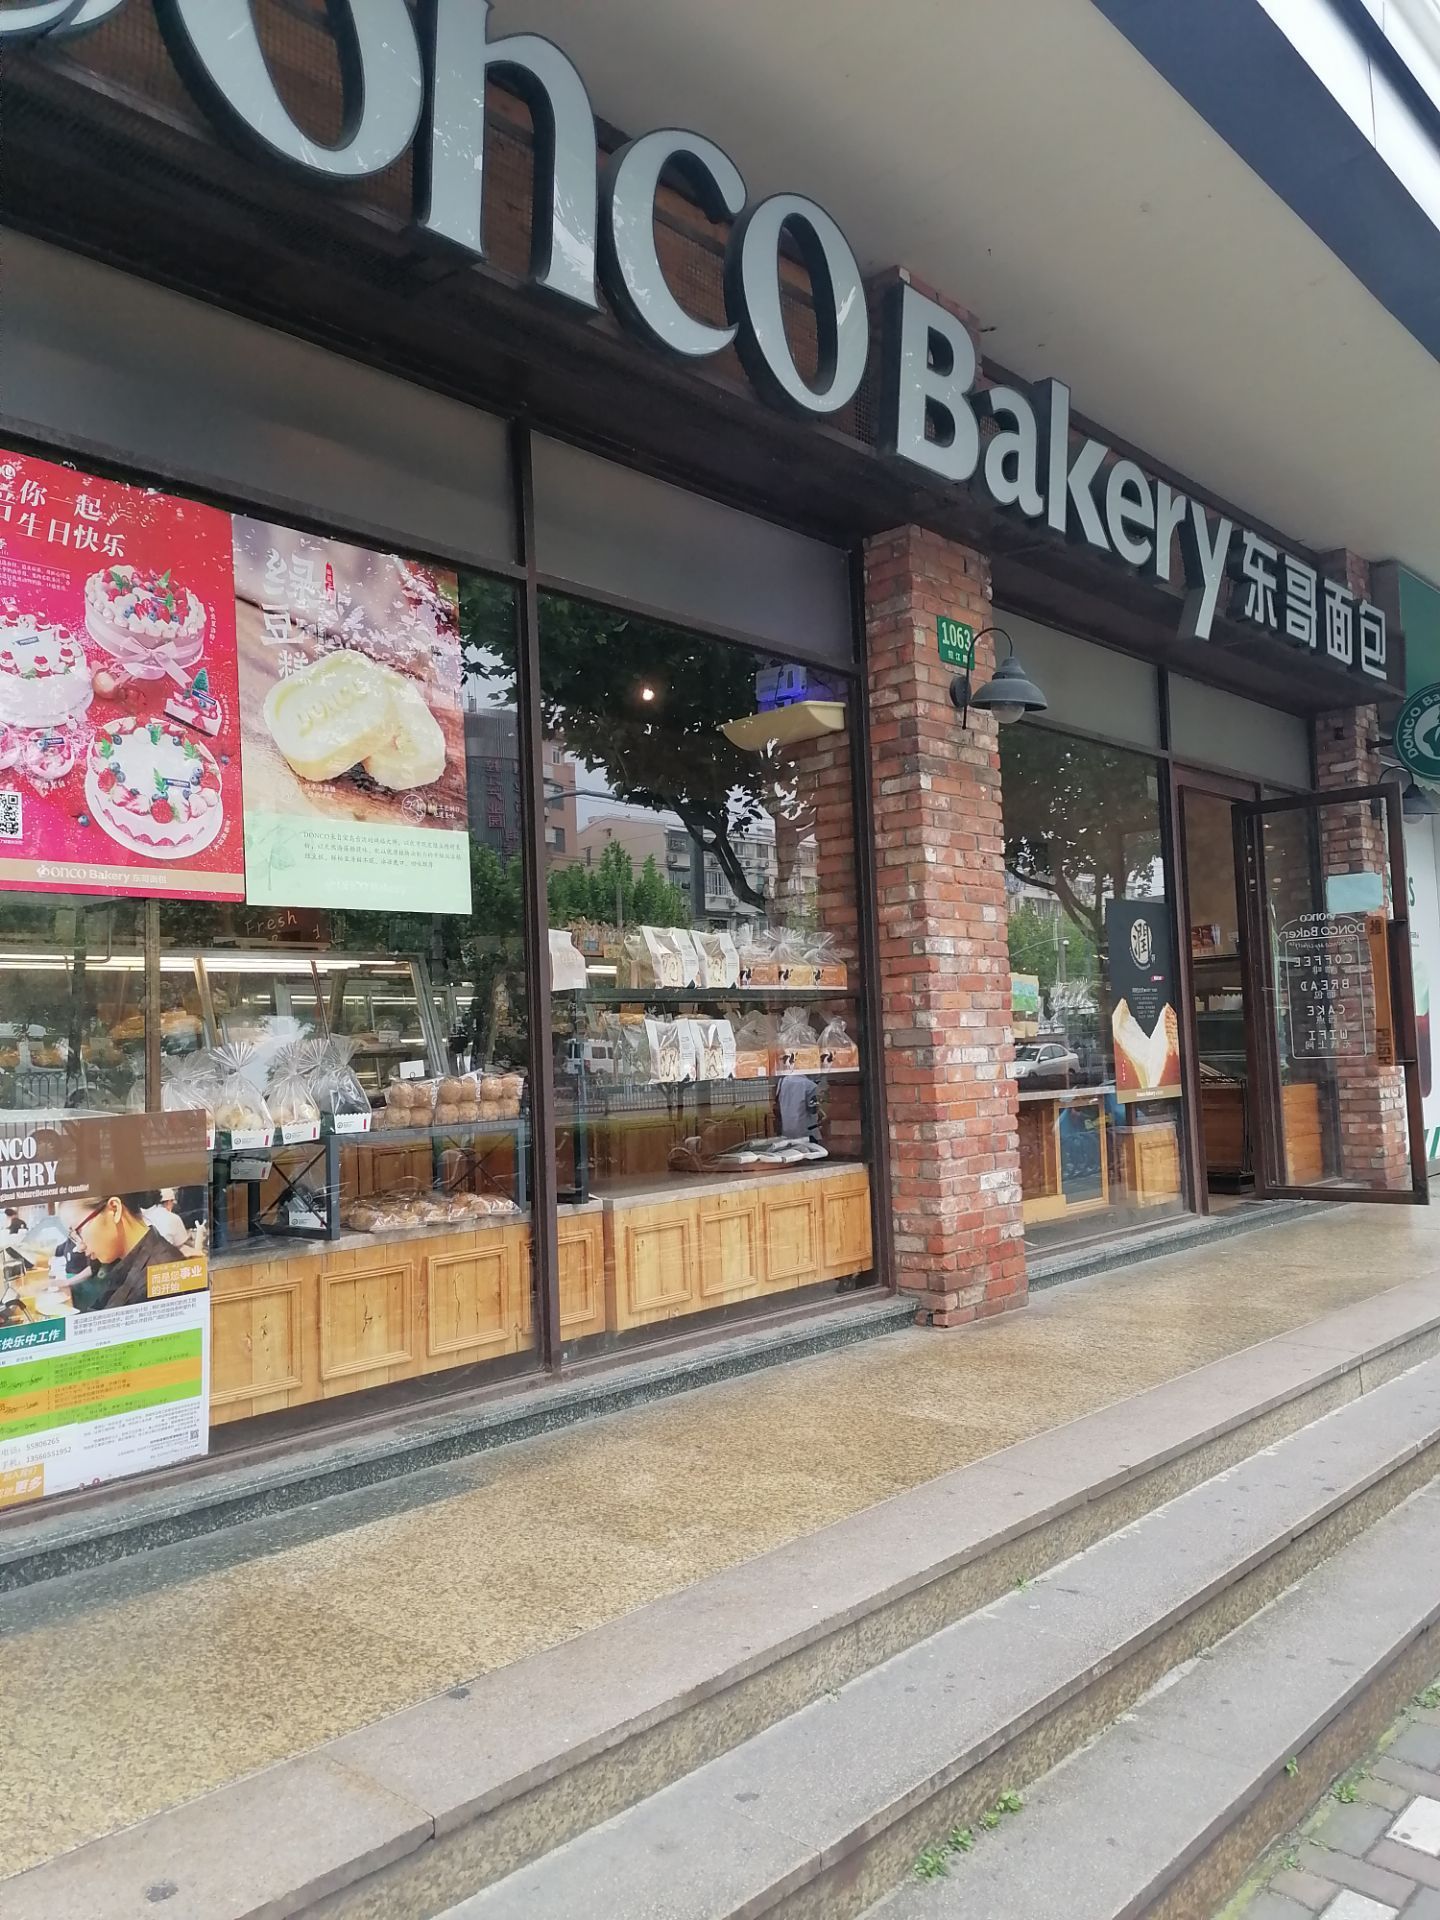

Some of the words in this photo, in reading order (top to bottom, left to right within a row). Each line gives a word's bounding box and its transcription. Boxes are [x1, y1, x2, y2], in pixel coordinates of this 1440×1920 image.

[897, 283, 1233, 641] Bakery
[1242, 530, 1388, 681] 东哥面包
[942, 621, 971, 651] 1063
[1402, 707, 1421, 759] DONCO
[88, 869, 131, 884] Bakery
[245, 910, 297, 936] Fresh
[1376, 1028, 1391, 1065] PUSH
[0, 1161, 59, 1190] KERY
